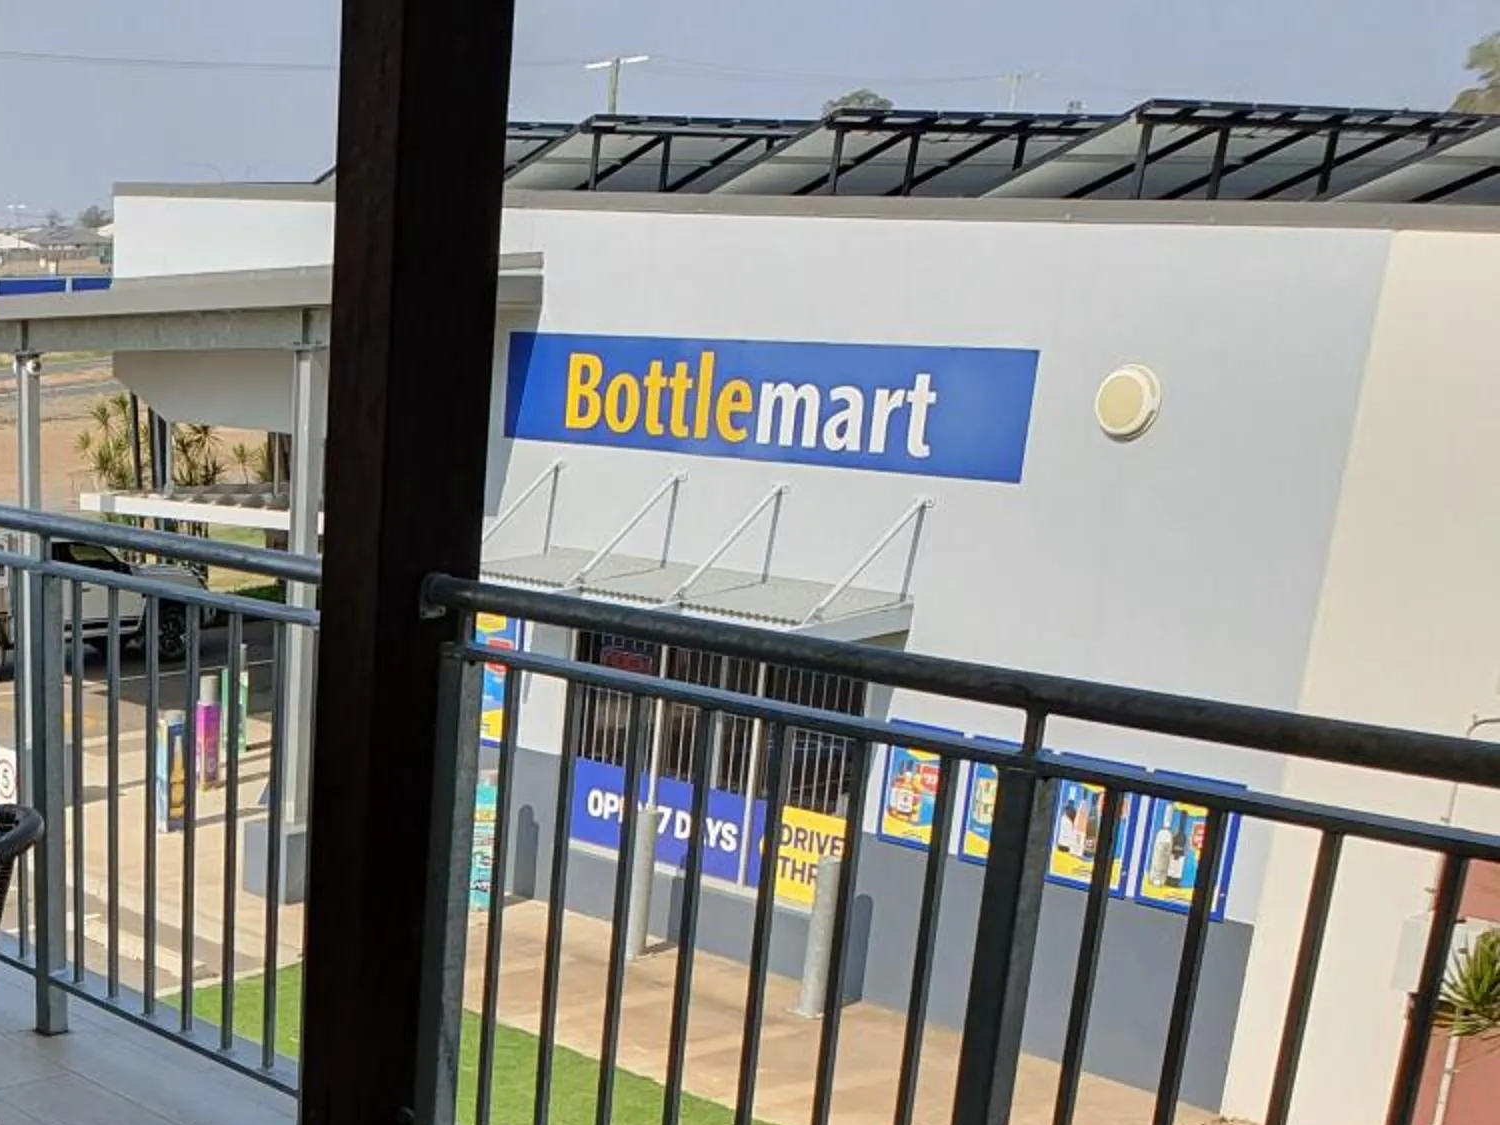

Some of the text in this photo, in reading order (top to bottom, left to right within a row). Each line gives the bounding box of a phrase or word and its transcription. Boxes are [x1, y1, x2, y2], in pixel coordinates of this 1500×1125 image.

[564, 351, 937, 459] Bottlemart
[1, 768, 11, 789] 5
[656, 805, 673, 834] 7
[674, 810, 739, 852] DYS
[779, 822, 845, 857] DRIVE
